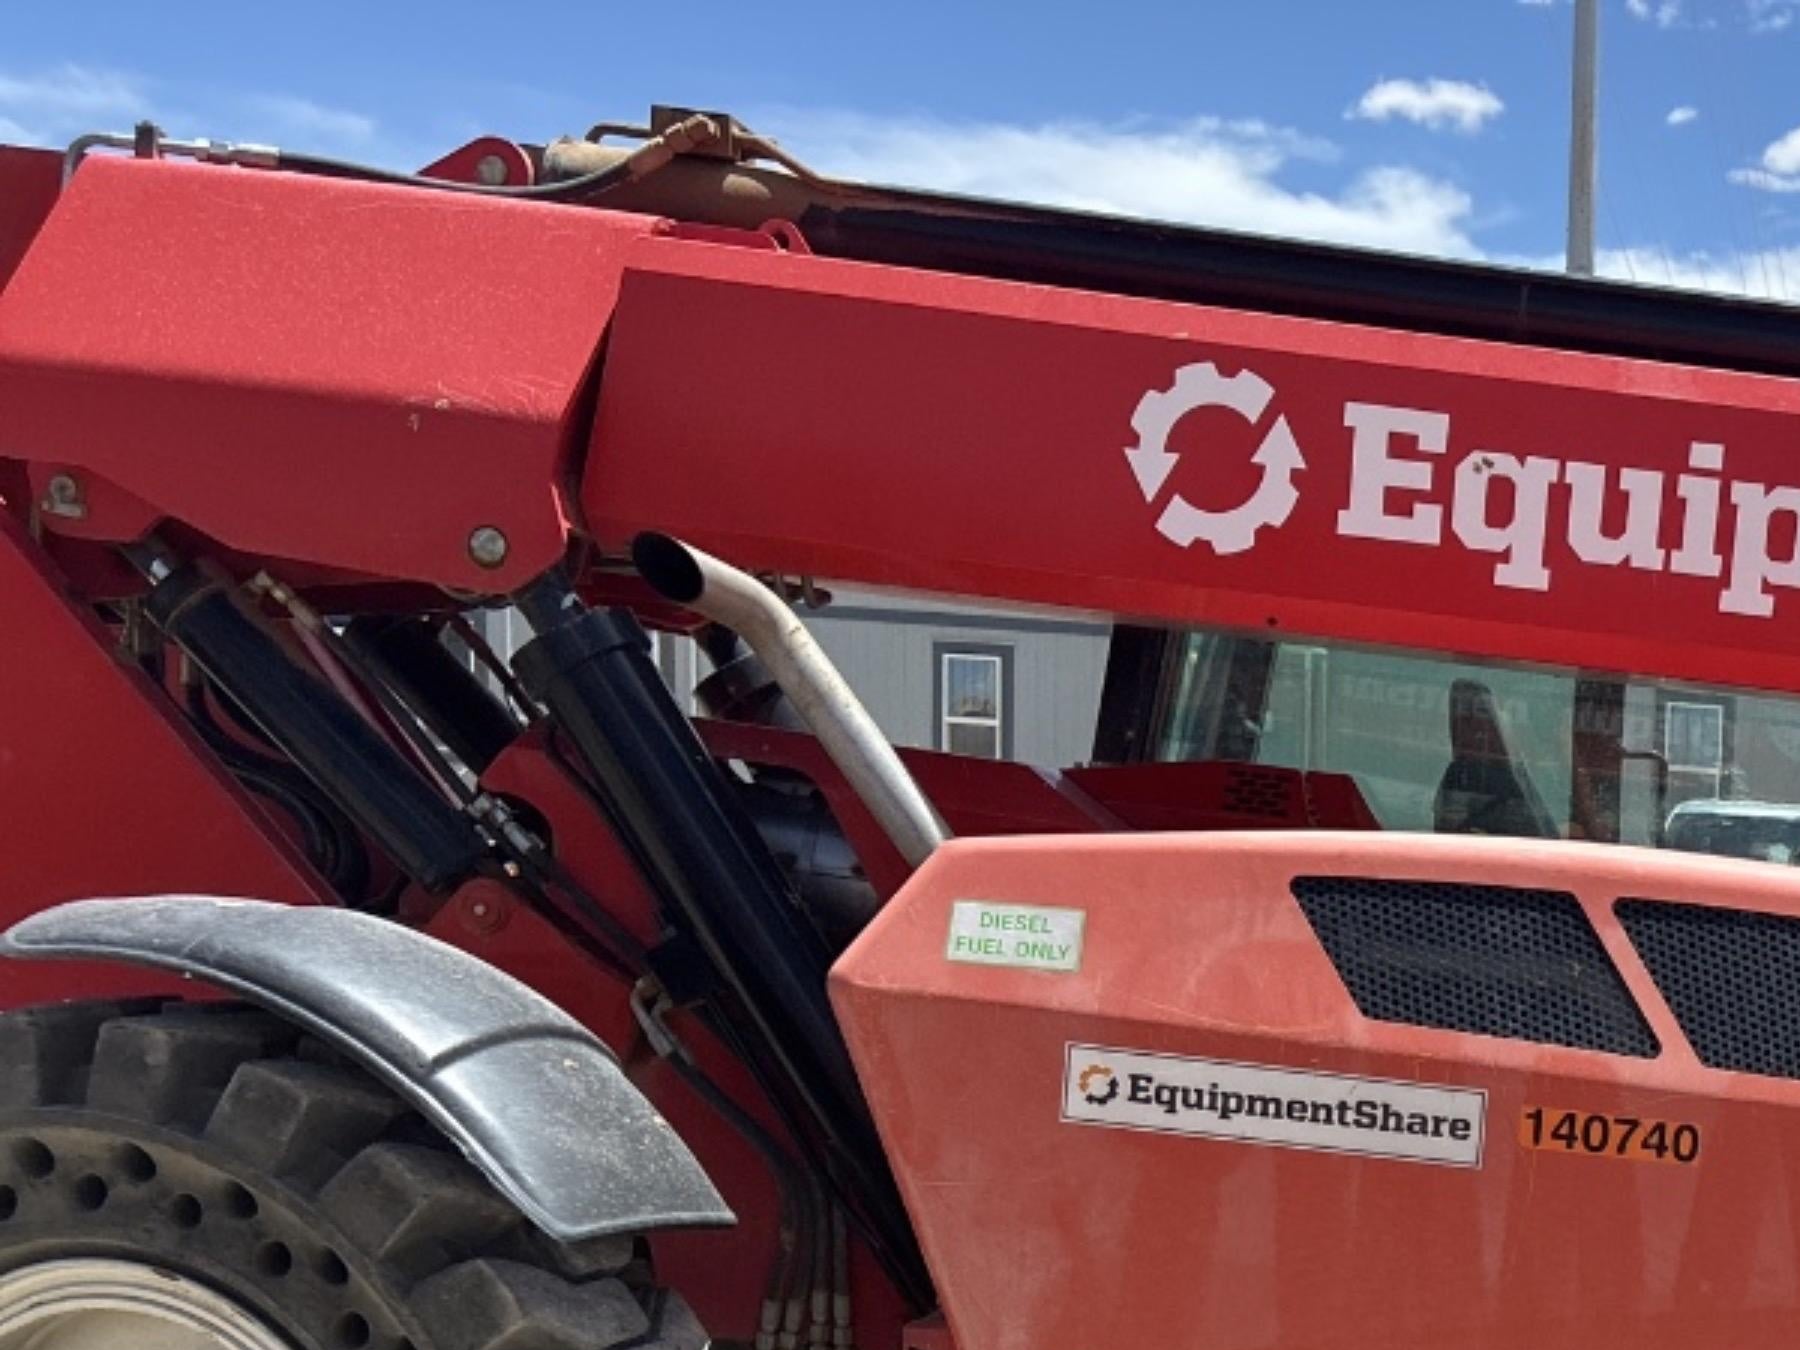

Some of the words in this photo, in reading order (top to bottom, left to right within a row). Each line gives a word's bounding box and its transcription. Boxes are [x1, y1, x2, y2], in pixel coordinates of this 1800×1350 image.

[979, 911, 1053, 935] DIESEL
[954, 935, 1005, 956] FUEL
[1015, 940, 1073, 962] ONLY
[1127, 1073, 1473, 1142] EquipmentShare
[1525, 1107, 1701, 1163] 140740
